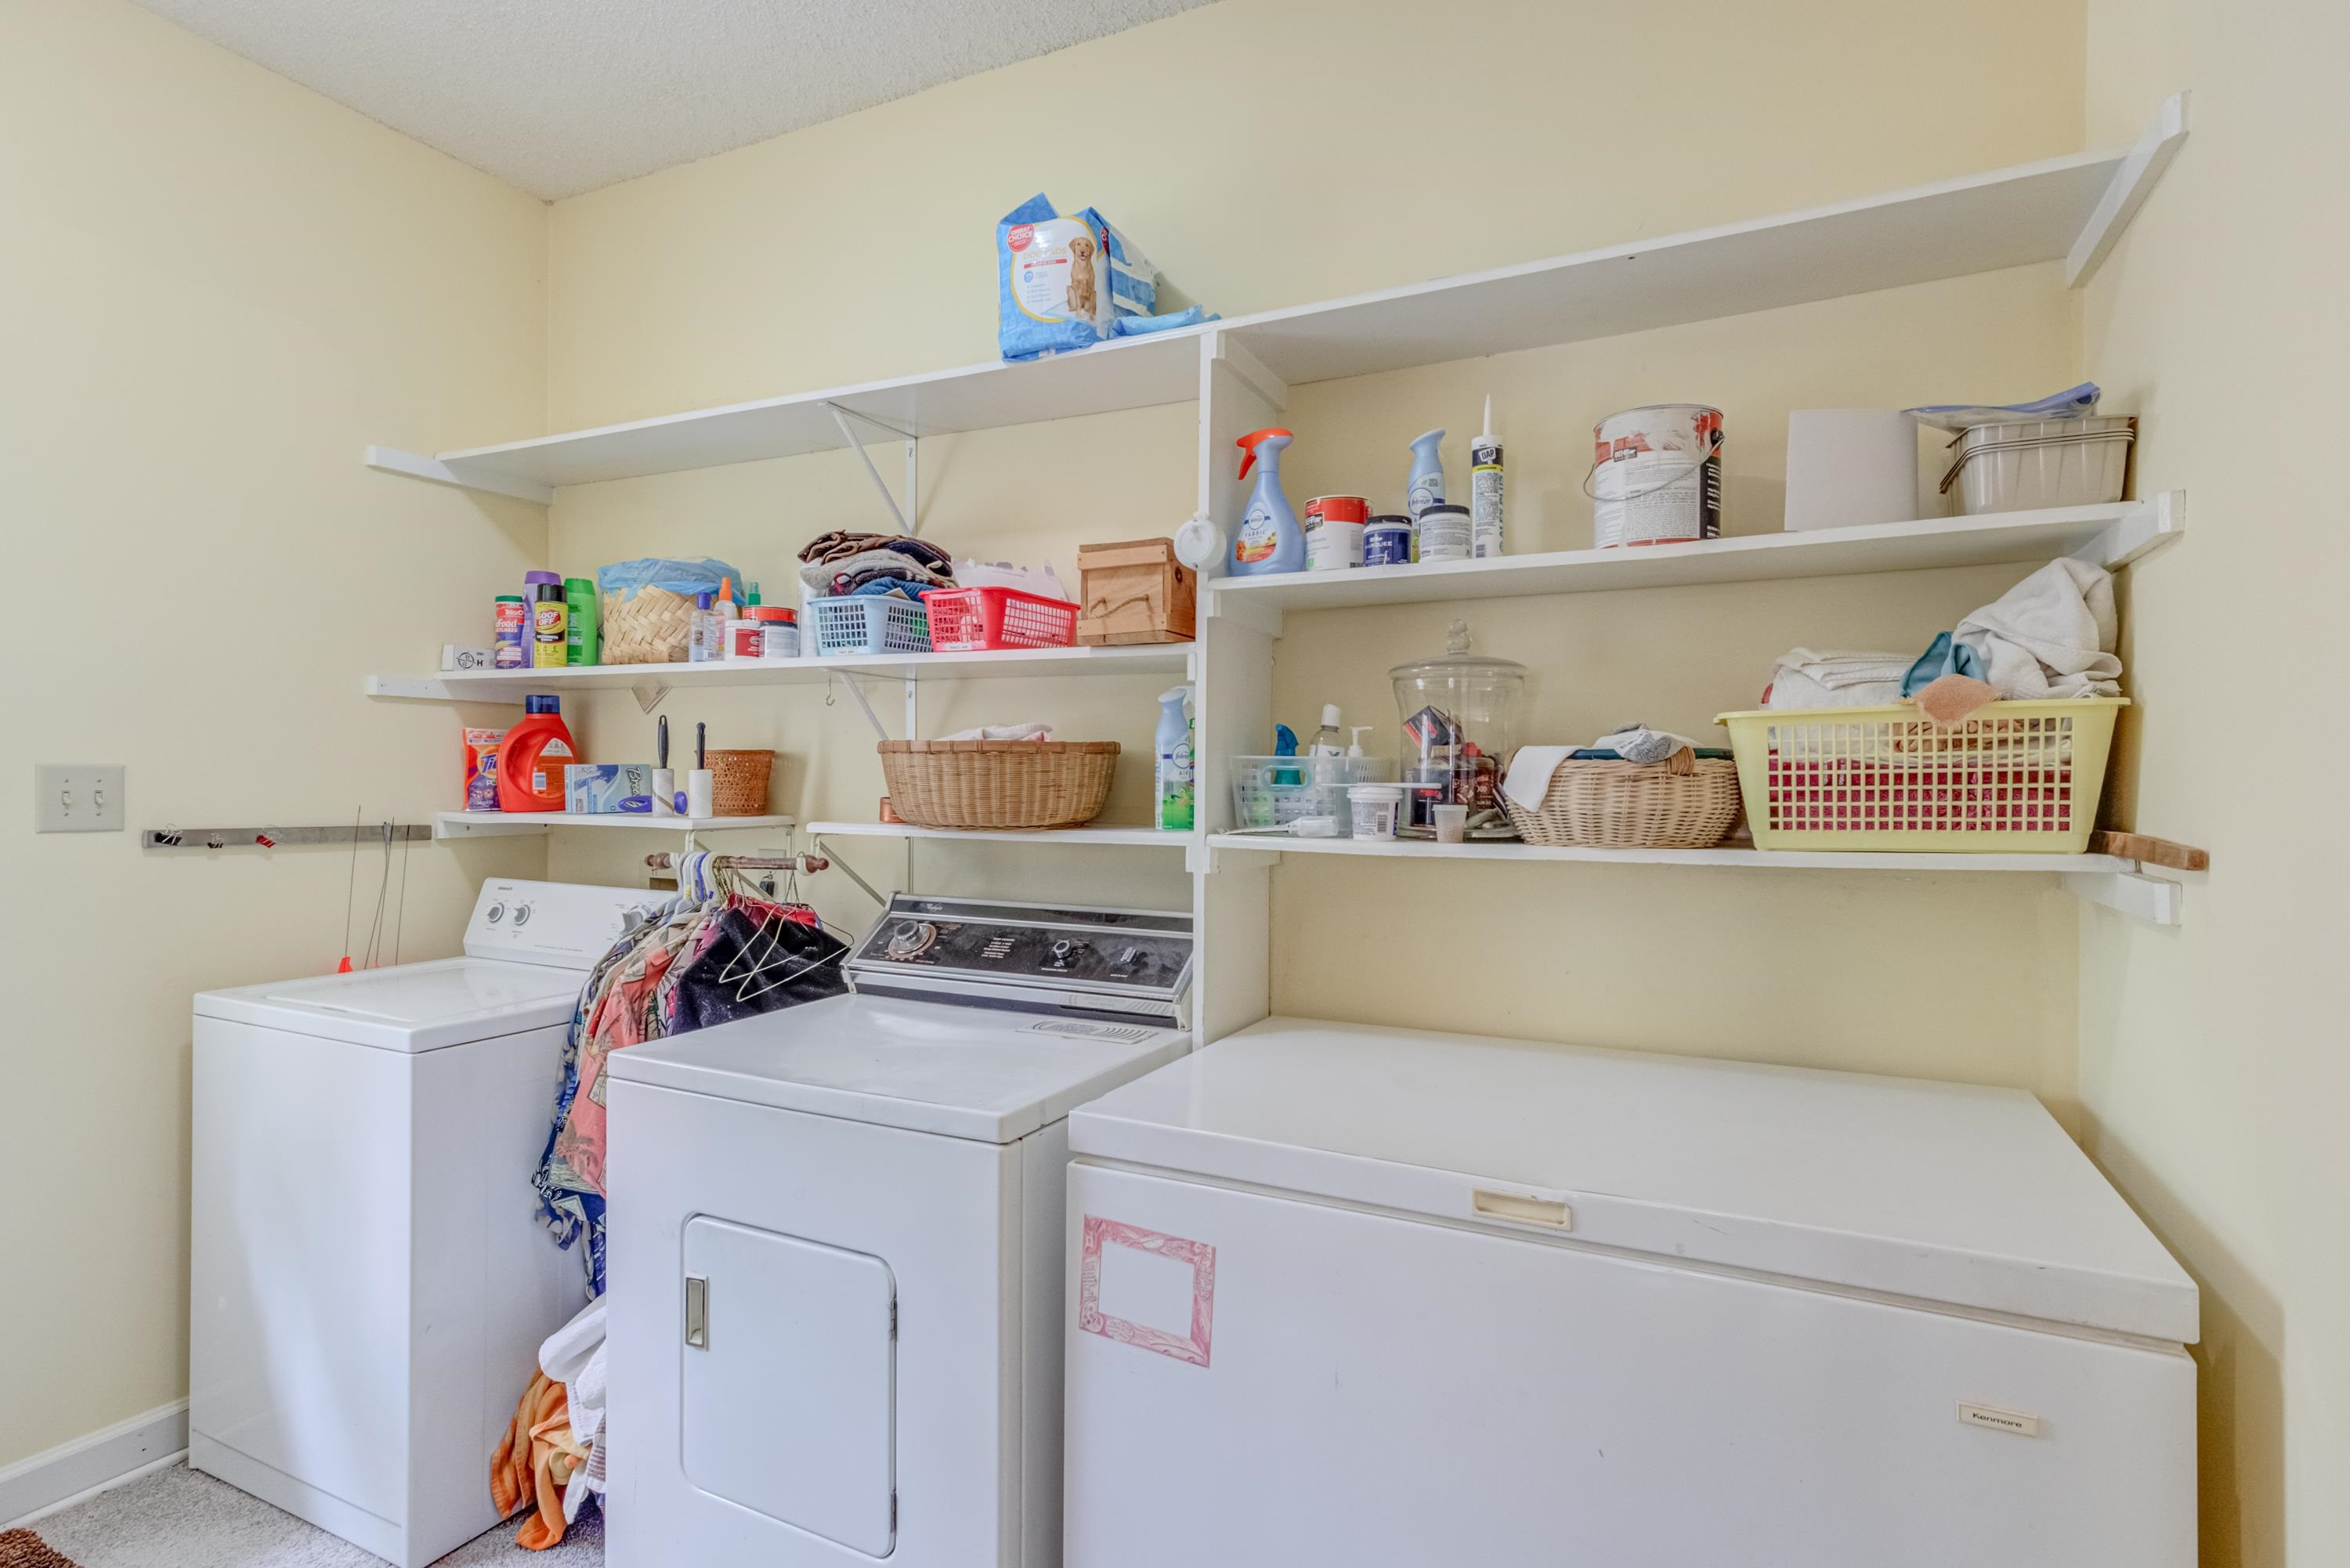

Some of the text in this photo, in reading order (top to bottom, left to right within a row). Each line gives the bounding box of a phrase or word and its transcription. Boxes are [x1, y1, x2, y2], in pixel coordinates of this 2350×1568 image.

[1481, 449, 1495, 460] DAP
[537, 611, 559, 620] GOOF
[1972, 1412, 2023, 1429] Kenmore
